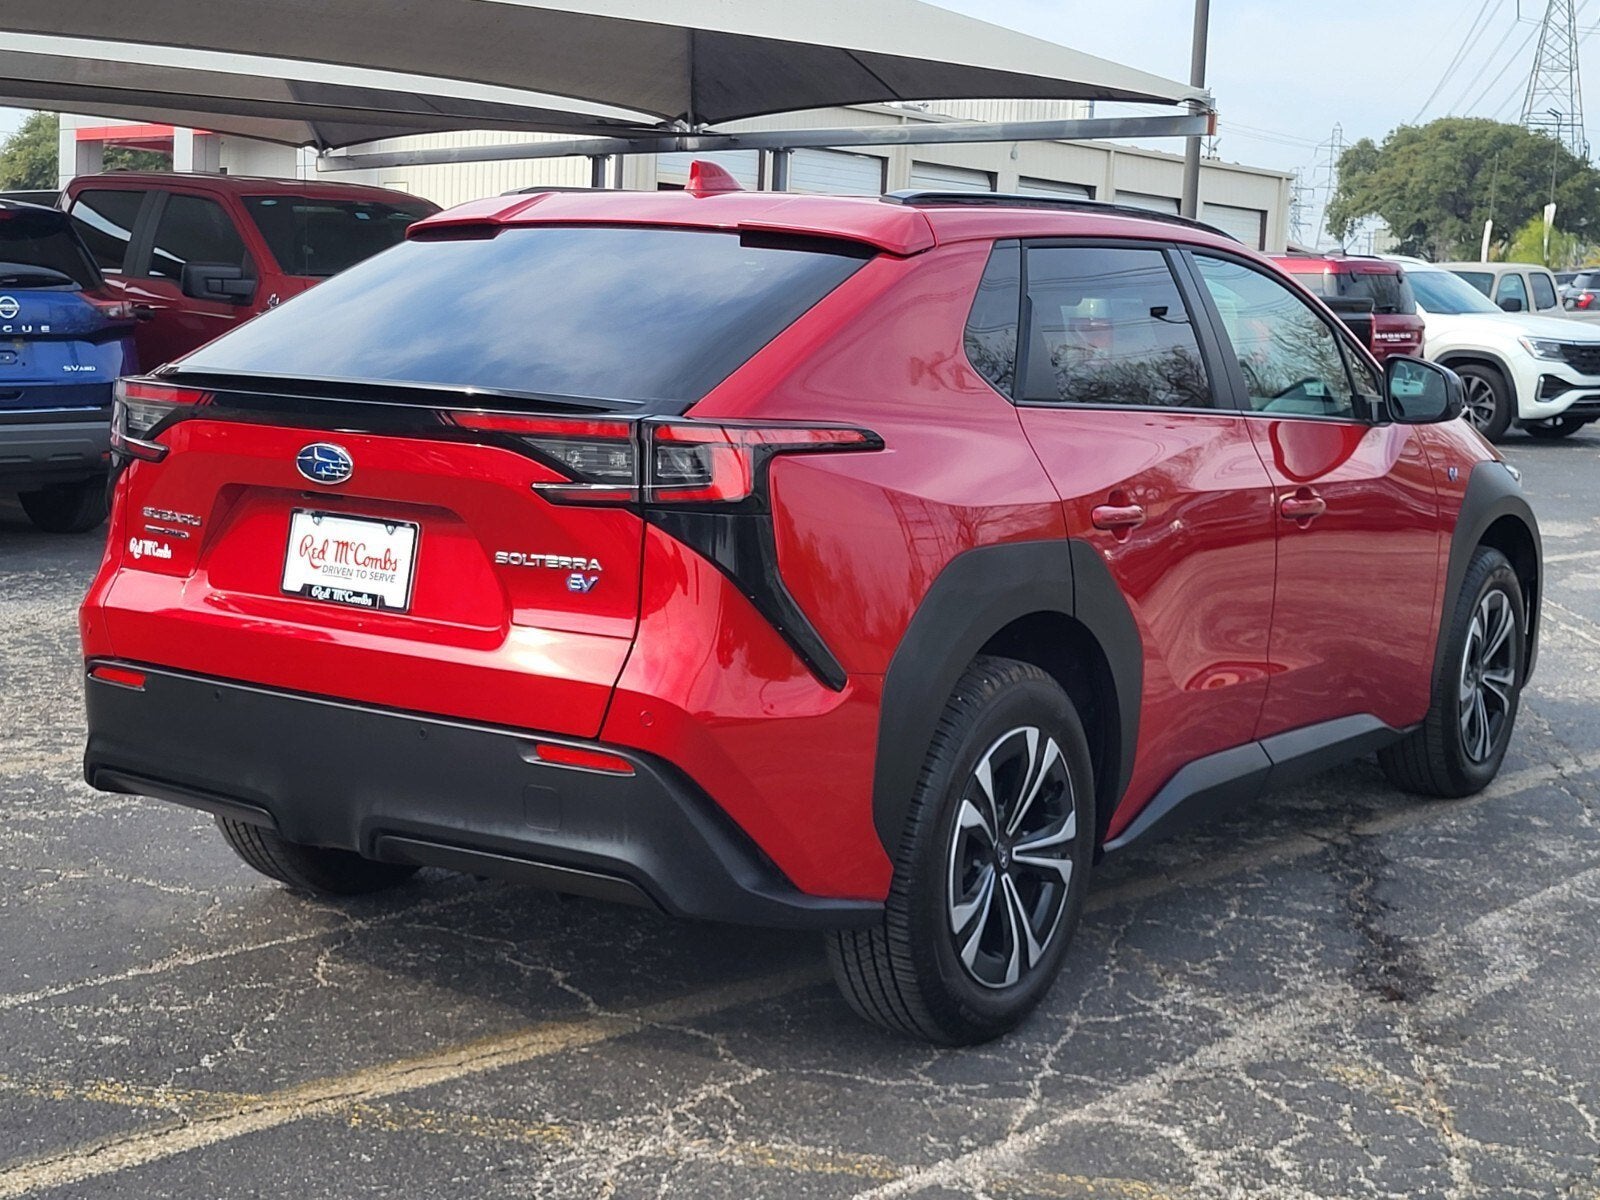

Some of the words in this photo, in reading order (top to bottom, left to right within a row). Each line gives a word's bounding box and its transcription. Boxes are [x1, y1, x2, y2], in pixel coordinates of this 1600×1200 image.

[142, 506, 201, 526] SUBARU
[300, 534, 329, 570] Red
[494, 550, 603, 572] SOLTERRA
[322, 564, 353, 577] DRIVEN
[356, 569, 367, 580] TO
[369, 570, 396, 584] SERVE
[568, 572, 599, 592] EV
